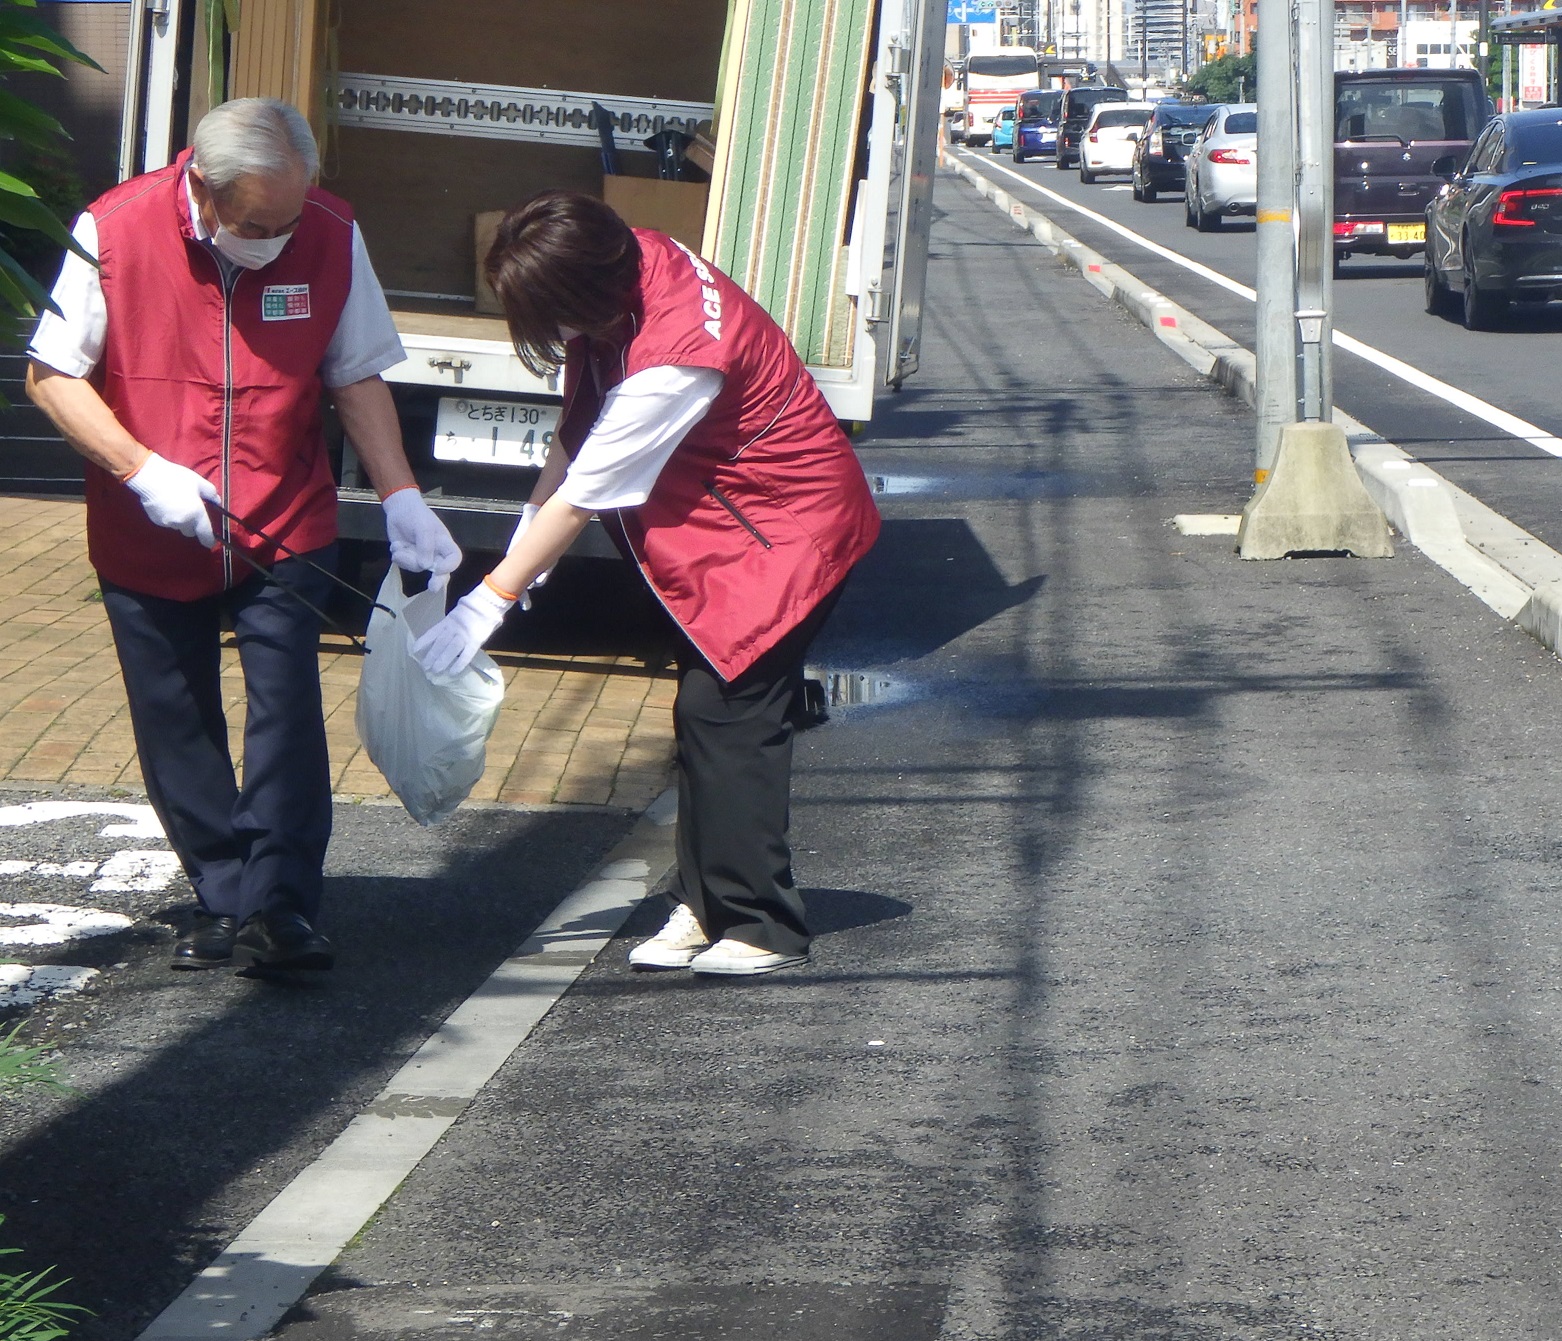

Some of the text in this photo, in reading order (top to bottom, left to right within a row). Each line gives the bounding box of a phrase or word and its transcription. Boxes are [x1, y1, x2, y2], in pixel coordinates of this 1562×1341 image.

[701, 284, 722, 341] ACE
[467, 403, 539, 425] とちぎ130
